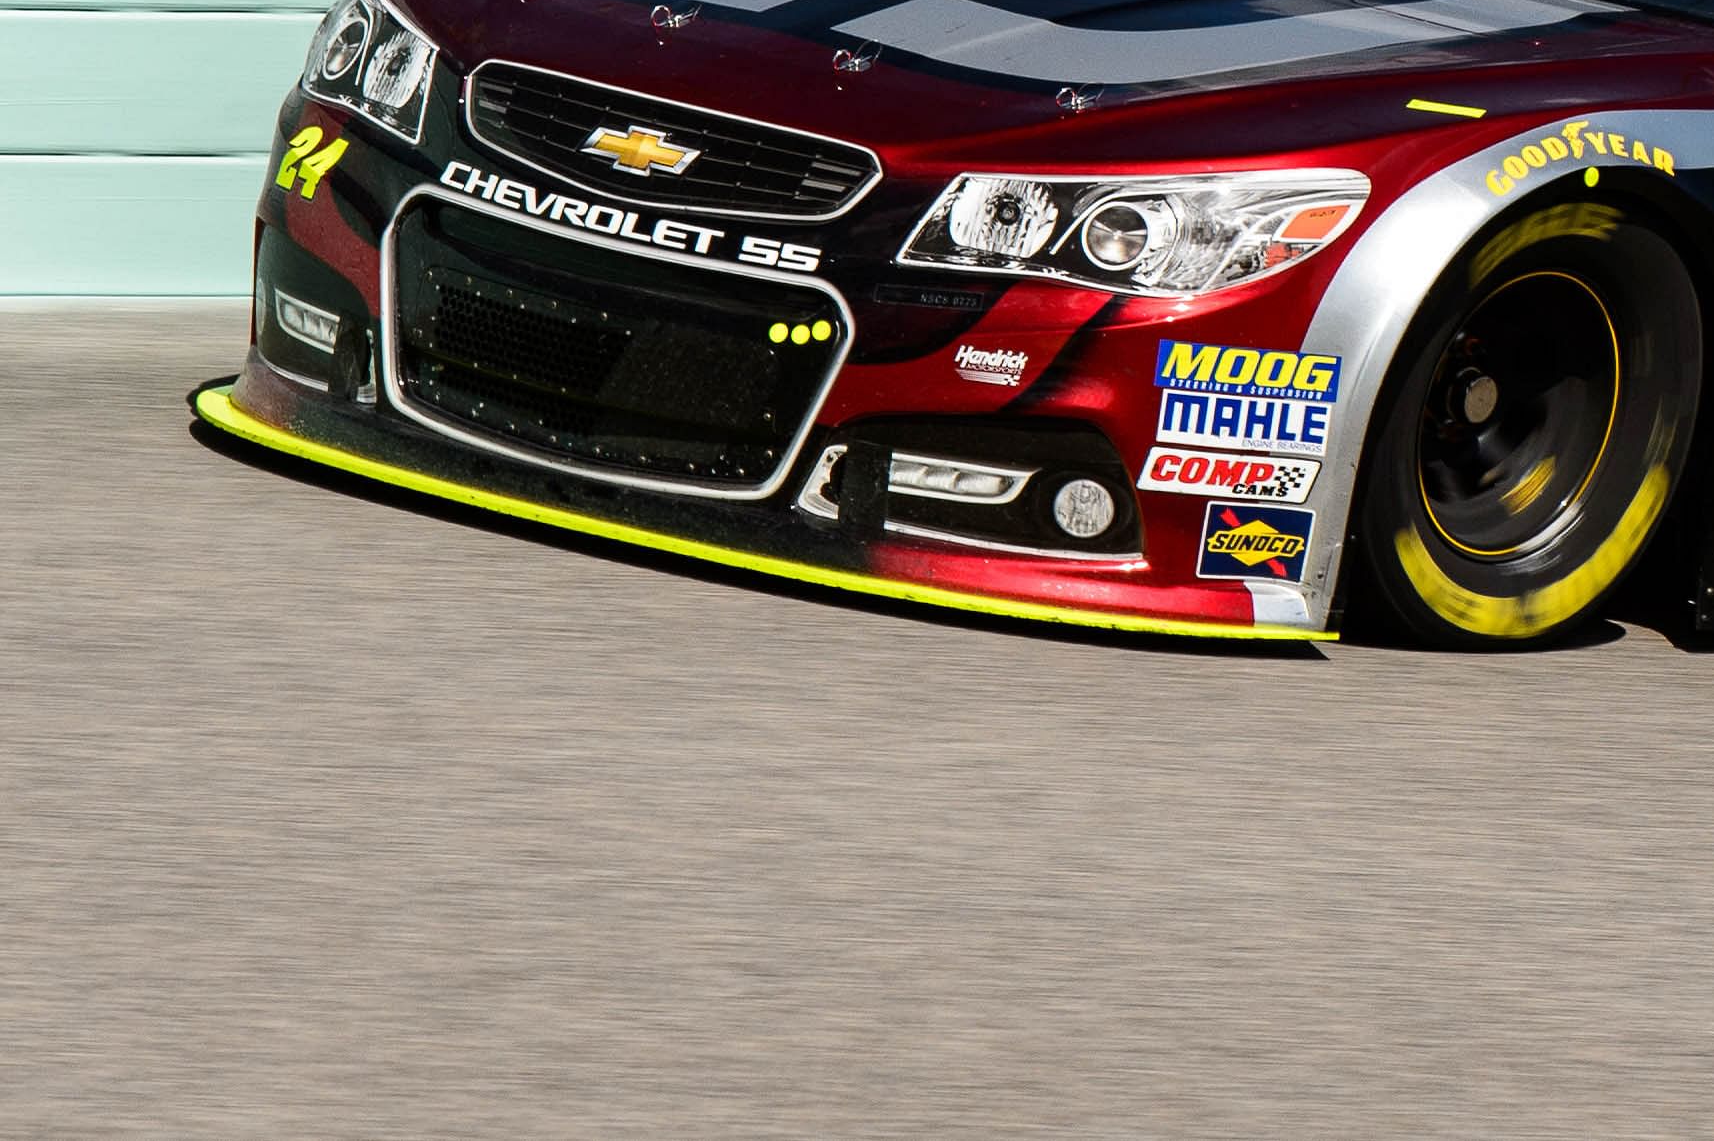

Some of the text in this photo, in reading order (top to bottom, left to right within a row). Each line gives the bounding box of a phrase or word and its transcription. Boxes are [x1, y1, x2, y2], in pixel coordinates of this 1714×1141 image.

[275, 126, 350, 200] 24
[1485, 120, 1675, 197] GOODYEAR
[440, 161, 821, 273] CHEVROLET SS
[954, 345, 1029, 370] Hendrick
[1161, 343, 1338, 392] MOOG
[1169, 378, 1324, 400] STEERING & SUSPENSION
[1162, 392, 1328, 444] MAHLE
[1242, 439, 1322, 453] ENGINE BEARINGS
[1150, 454, 1276, 487] COMP
[1232, 483, 1289, 498] CAMS
[1212, 533, 1301, 555] SUNOCO
